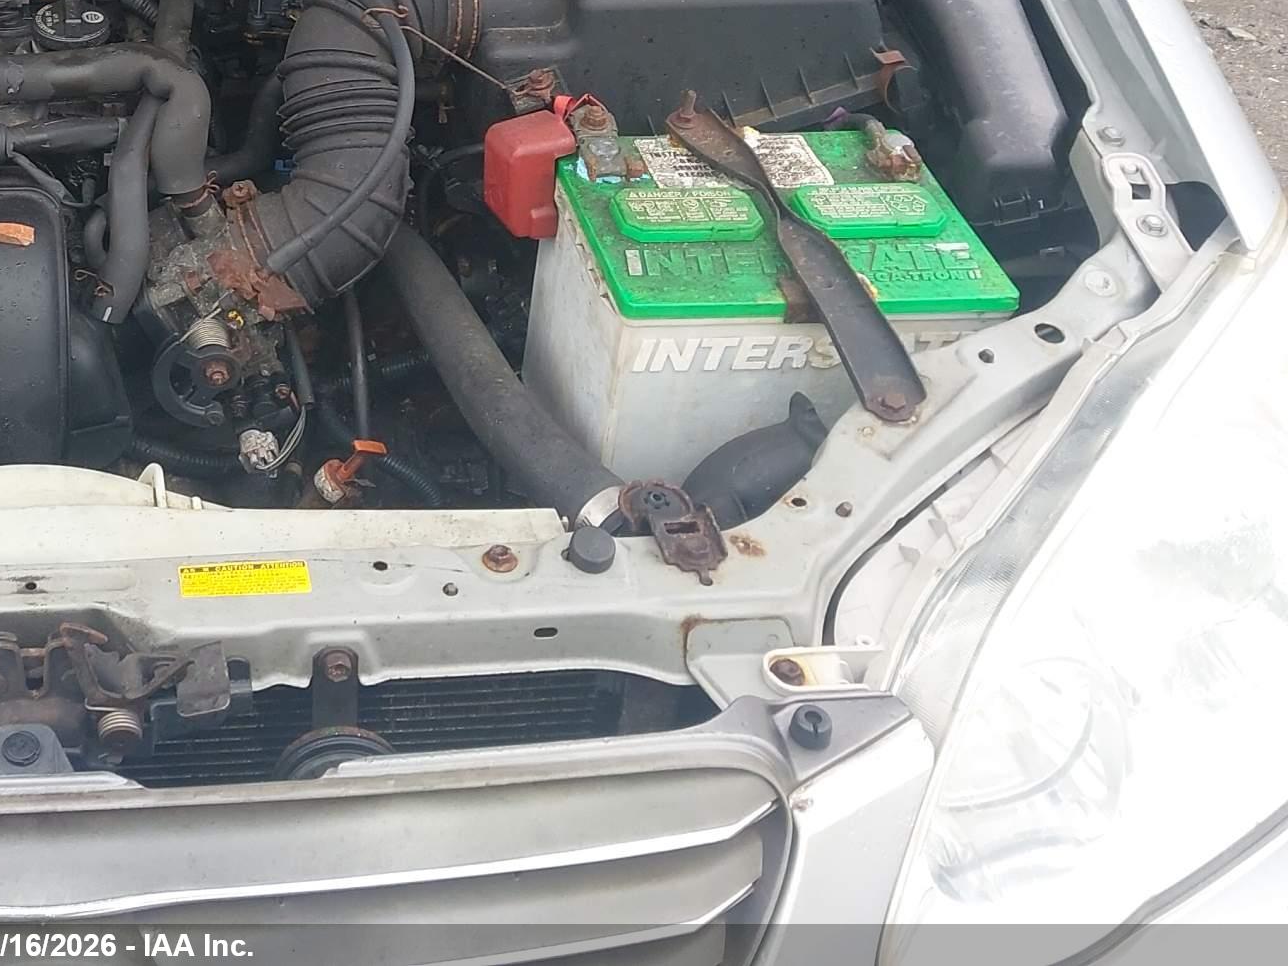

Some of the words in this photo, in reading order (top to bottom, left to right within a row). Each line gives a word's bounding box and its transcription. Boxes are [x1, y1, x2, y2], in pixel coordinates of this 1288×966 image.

[637, 190, 682, 198] DANGER
[691, 190, 732, 198] POISON
[215, 563, 254, 572] CAUTION
